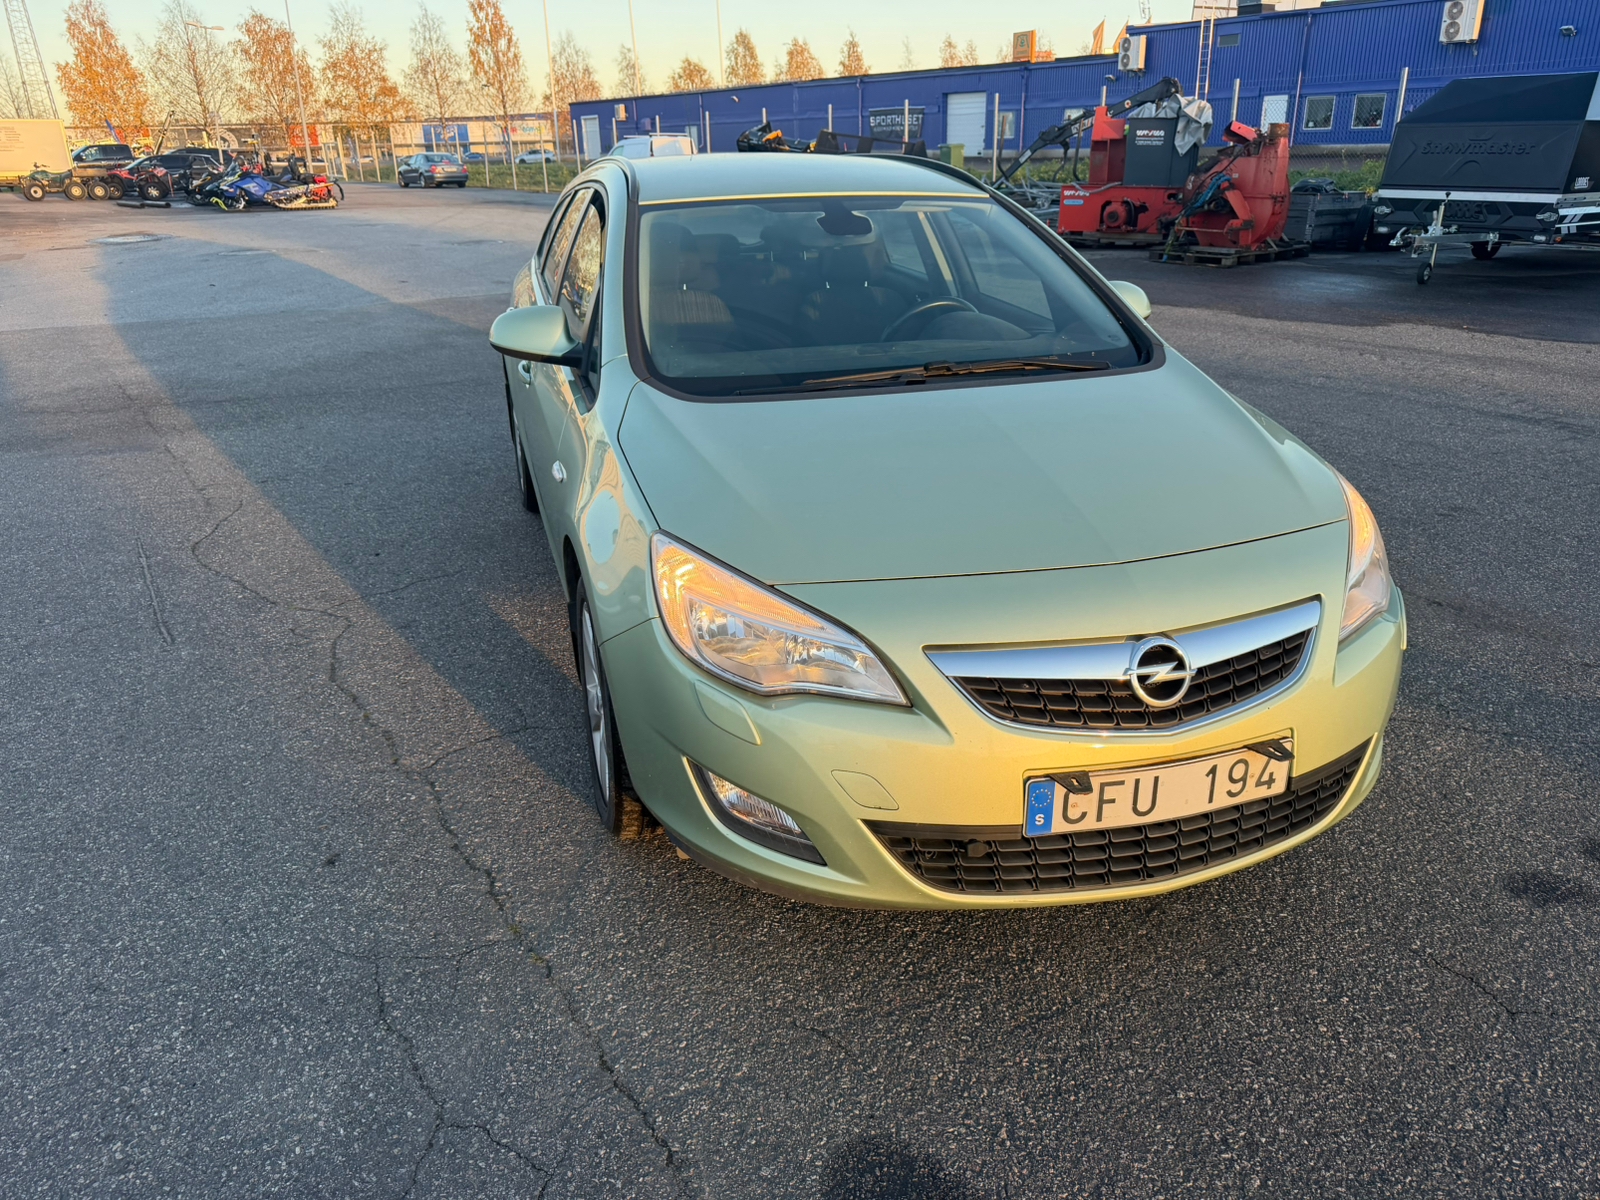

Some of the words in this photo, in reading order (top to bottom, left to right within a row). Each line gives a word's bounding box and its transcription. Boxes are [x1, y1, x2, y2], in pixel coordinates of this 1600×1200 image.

[1061, 775, 1160, 825] CFU
[1204, 757, 1277, 805] 194
[1034, 813, 1045, 826] S
